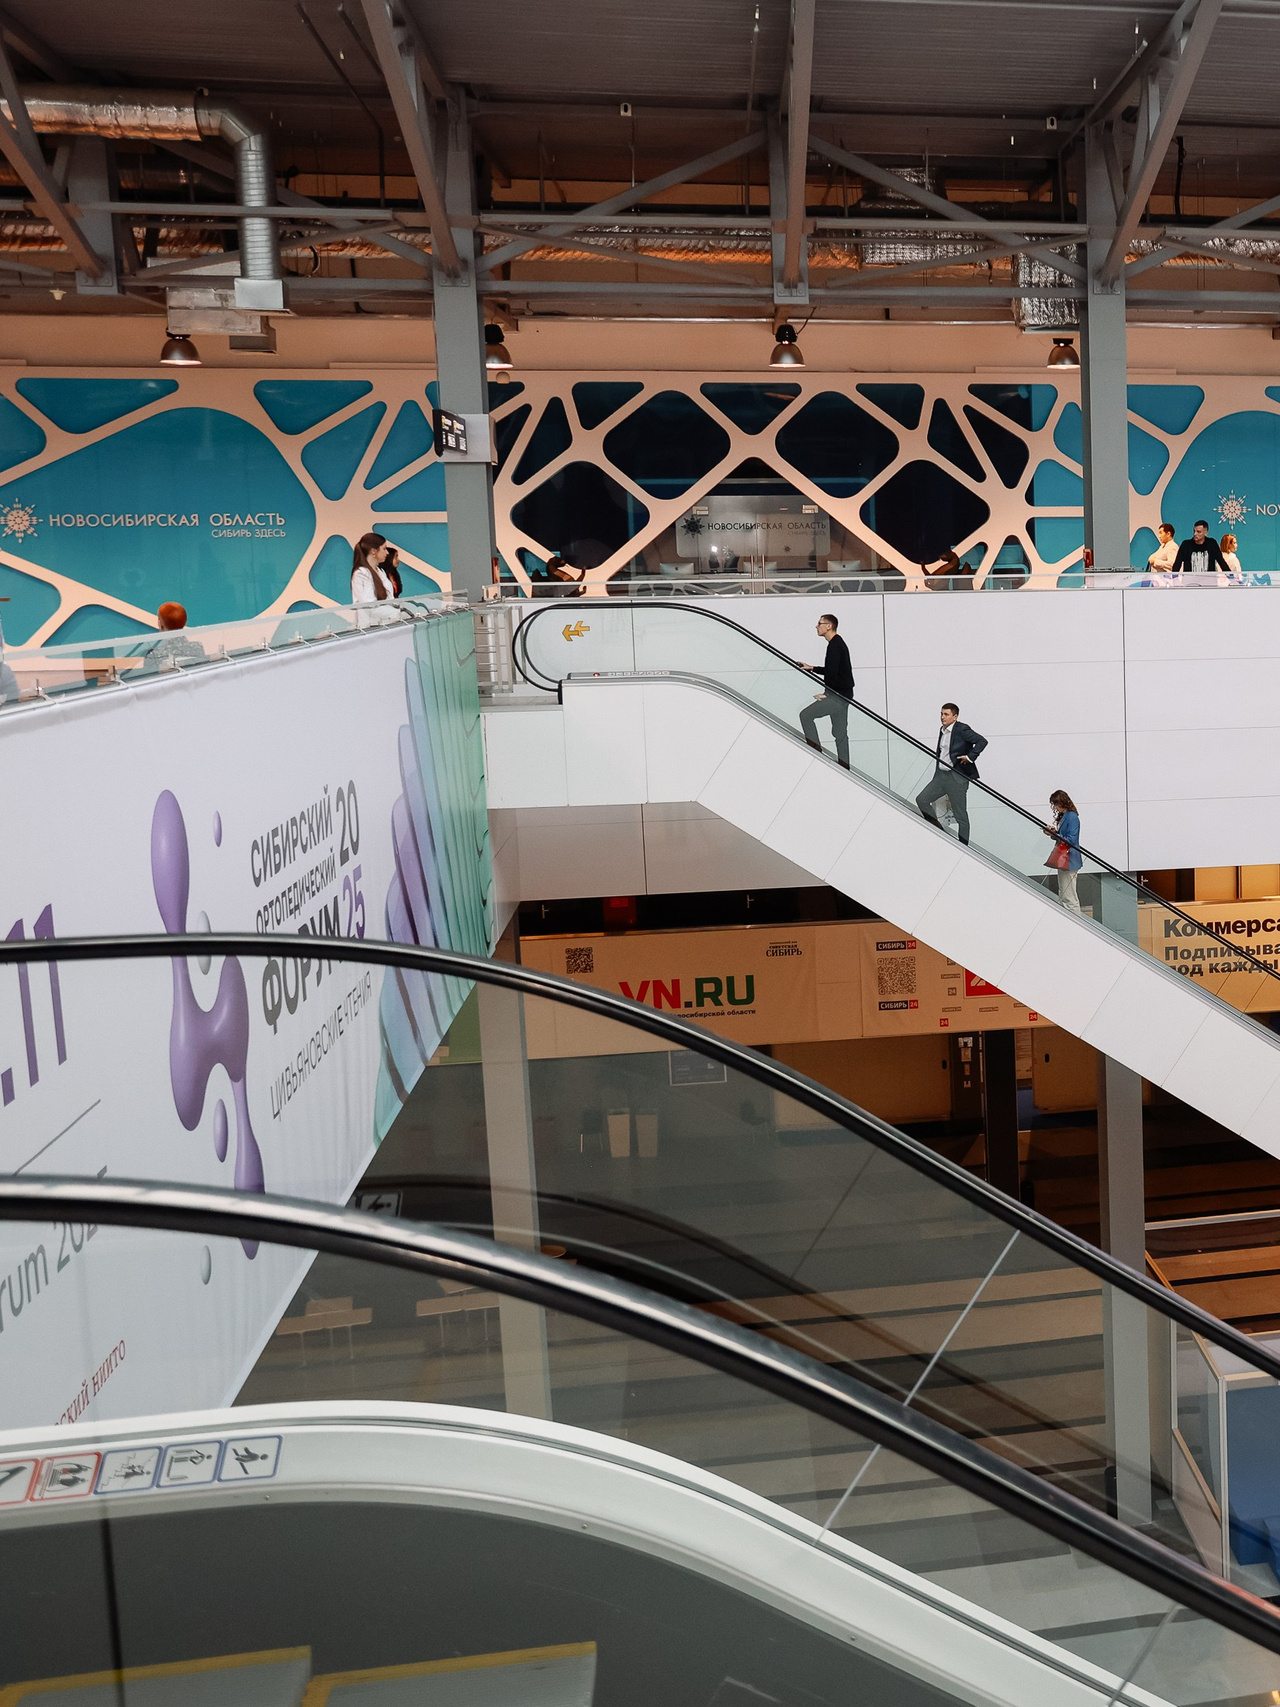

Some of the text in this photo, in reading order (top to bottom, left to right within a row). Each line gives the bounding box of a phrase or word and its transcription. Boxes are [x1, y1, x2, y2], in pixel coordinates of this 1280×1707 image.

[49, 513, 286, 527] НОВОСИБИРСКАЯ ОБЛАСТЬ
[707, 521, 827, 531] НОВОСИБИРСКАЯ ОБЛАСТЬ
[211, 528, 286, 538] СИБИРЬ ЗДЕСЬ
[251, 779, 360, 888] СИБИРСКИЙ 20
[256, 846, 337, 936] ОРТОПЕДИЧЕСКИЙ
[878, 941, 905, 950] СИБИРЬ
[765, 948, 803, 957] СИБИРЬ
[618, 974, 756, 1010] VN.RU
[880, 1000, 918, 1009] СИБИРЬ 24
[727, 1008, 757, 1016] области
[269, 970, 373, 1122] ЦИВЬЯНОВСКИЕ ЧТЕНИЯ
[93, 1339, 127, 1397] НИИТО
